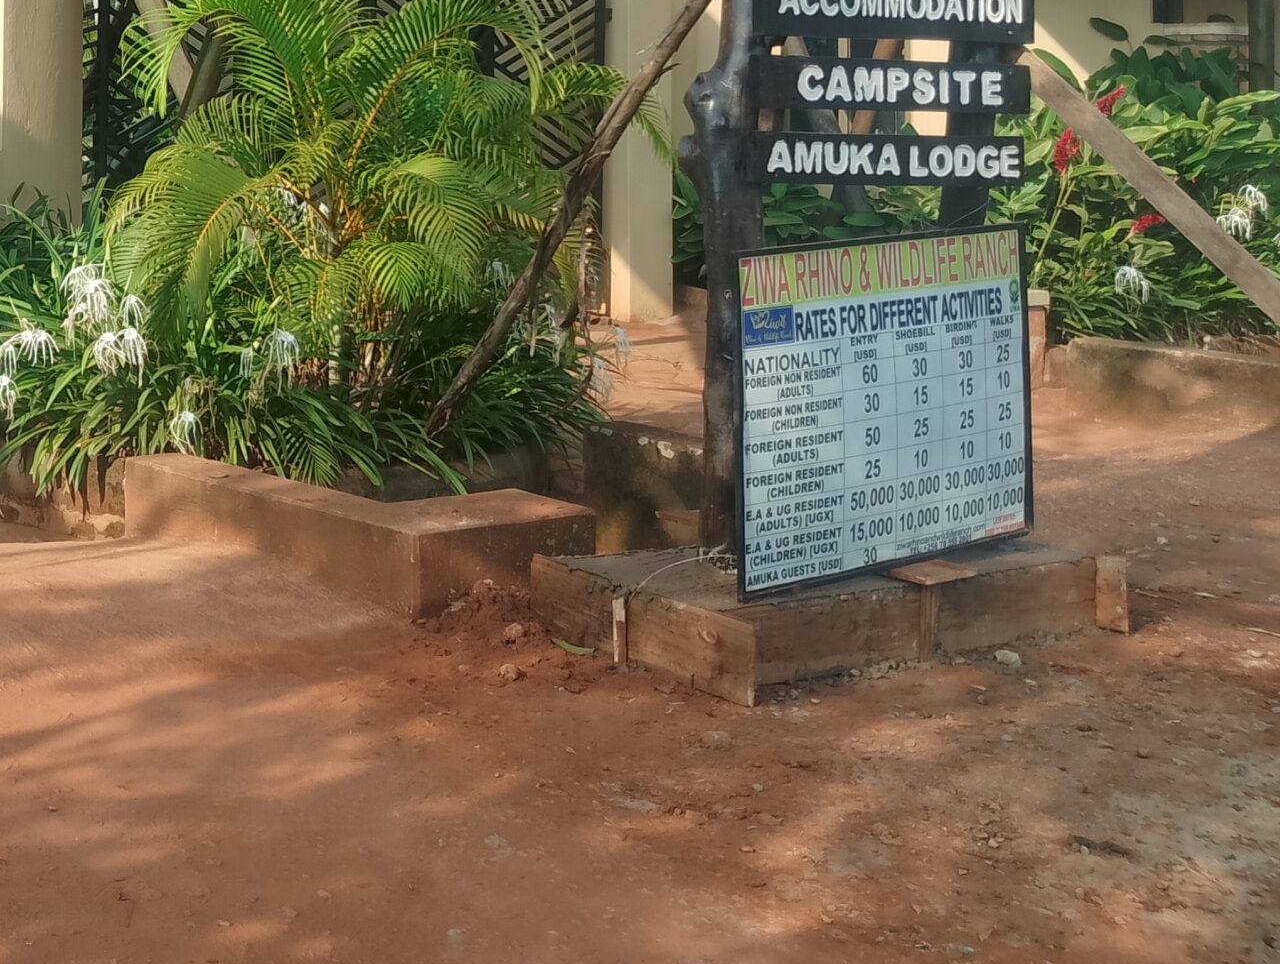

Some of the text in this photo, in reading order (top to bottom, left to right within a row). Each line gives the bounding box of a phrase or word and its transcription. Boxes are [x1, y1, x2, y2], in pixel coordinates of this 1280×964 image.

[797, 65, 1004, 106] CAMPSITE
[767, 139, 1021, 179] AMUKA LODGE
[740, 231, 1018, 306] ZIWA RHINO & WILDLIFE RANCH
[795, 286, 1003, 342] RATES FOR DIFFERENT ACTIVITIES
[989, 315, 1014, 326] WALKS
[895, 326, 936, 340] SHOEBILL
[945, 320, 977, 333] BIRDING
[992, 329, 1012, 342] [USD]
[850, 334, 878, 347] ENTRY
[905, 341, 928, 355] [USD]
[951, 335, 973, 348] [USD]
[744, 347, 840, 376] NATIONALITY
[854, 348, 877, 362] [USD]
[959, 350, 973, 369] 30
[996, 343, 1010, 363] 25
[862, 363, 878, 384] 60
[912, 357, 927, 377] 30
[745, 366, 841, 390] FOREIGN NON RESIDENT
[959, 377, 973, 397] 15
[997, 370, 1010, 390] 10
[777, 383, 814, 402] (ADULTS)
[913, 385, 928, 406] 15
[744, 397, 843, 422] FOREIGN NON RESIDENT
[864, 393, 880, 414] 30
[998, 402, 1012, 422] 25
[772, 414, 819, 434] (CHILDREN)
[914, 417, 929, 438] 25
[960, 409, 974, 430] 25
[745, 430, 844, 455] FOREIGN RESIDENT
[865, 426, 881, 447] 50
[998, 431, 1011, 451] 10
[772, 448, 819, 468] (ADULTS)
[914, 448, 928, 469] 10
[960, 440, 974, 460] 10
[746, 463, 844, 489] FOREIGN RESIDENT
[865, 458, 881, 479] 25
[945, 466, 985, 492] 30,000
[987, 456, 1024, 482] 30,000
[767, 480, 825, 502] (CHILDREN)
[850, 485, 894, 512] 50,000
[900, 475, 940, 501] 30,000
[746, 495, 844, 522] E.A & UG RESIDENT
[987, 486, 1024, 512] 10,000
[900, 506, 940, 533] 10,000
[945, 497, 984, 524] 10,000
[755, 510, 834, 536] (ADULTS) [UGX]
[850, 516, 893, 543] 15,000
[745, 527, 843, 555] E.A & UG RESIDENT
[749, 541, 838, 570] (CHILDREN) [UGX]
[863, 547, 877, 565] 30
[747, 558, 842, 587] AMUKA GUESTS [USD]
